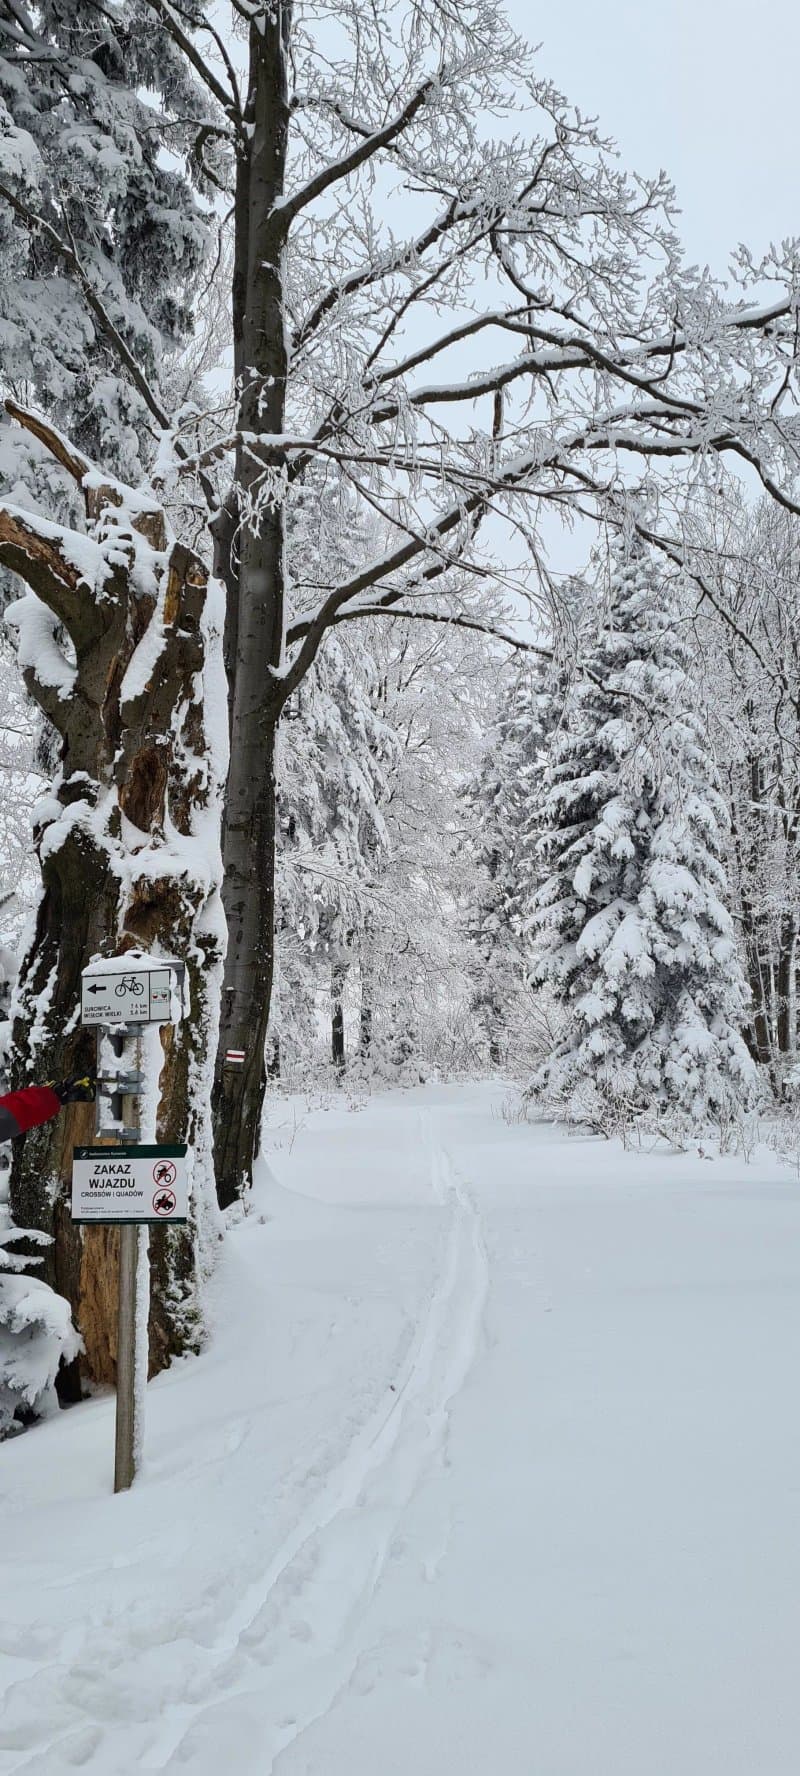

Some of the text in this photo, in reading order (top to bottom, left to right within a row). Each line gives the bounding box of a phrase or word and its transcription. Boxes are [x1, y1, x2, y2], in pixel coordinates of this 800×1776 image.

[94, 1164, 131, 1175] ZAKAZ
[89, 1178, 135, 1189] WJAZDU
[81, 1190, 111, 1198] CROSSÓW
[116, 1190, 144, 1198] QUADÓW
